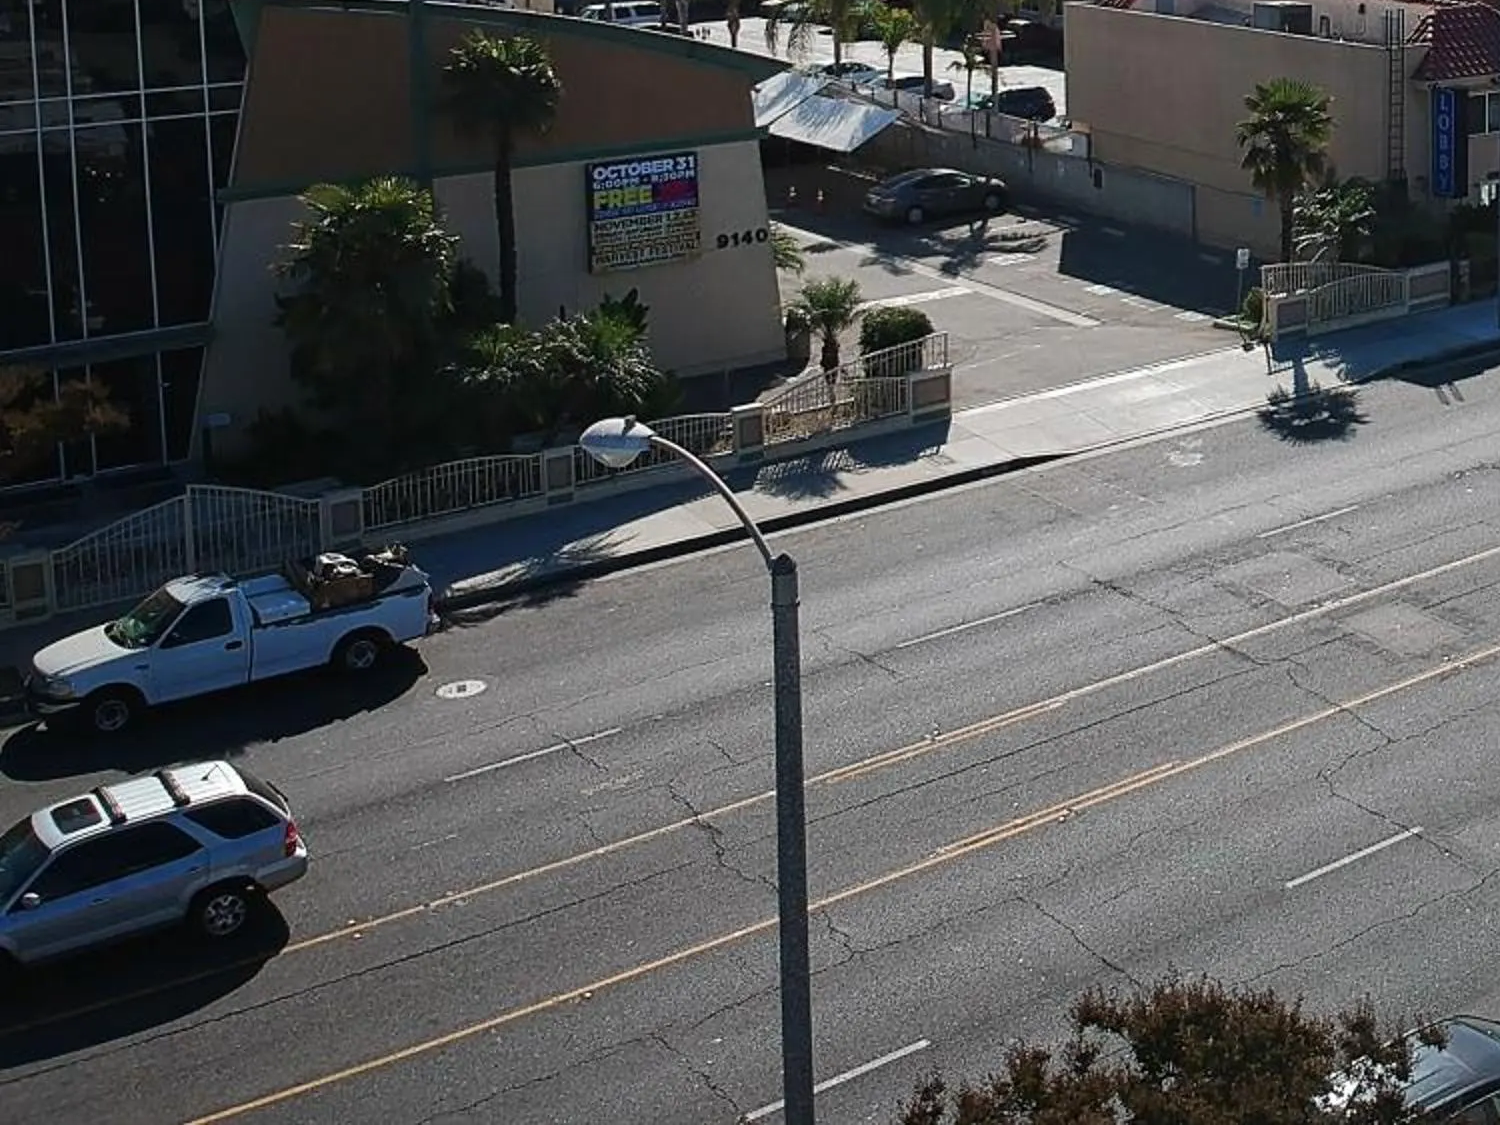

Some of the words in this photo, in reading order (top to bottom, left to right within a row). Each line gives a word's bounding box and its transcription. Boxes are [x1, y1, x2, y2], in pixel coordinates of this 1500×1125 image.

[1437, 94, 1450, 190] LOBBY
[593, 159, 674, 181] OCTOBER
[676, 155, 695, 170] 31
[593, 177, 640, 190] 6:00PM
[594, 185, 653, 209] FREE
[594, 215, 663, 231] NOVEMBER
[716, 228, 768, 249] 9140
